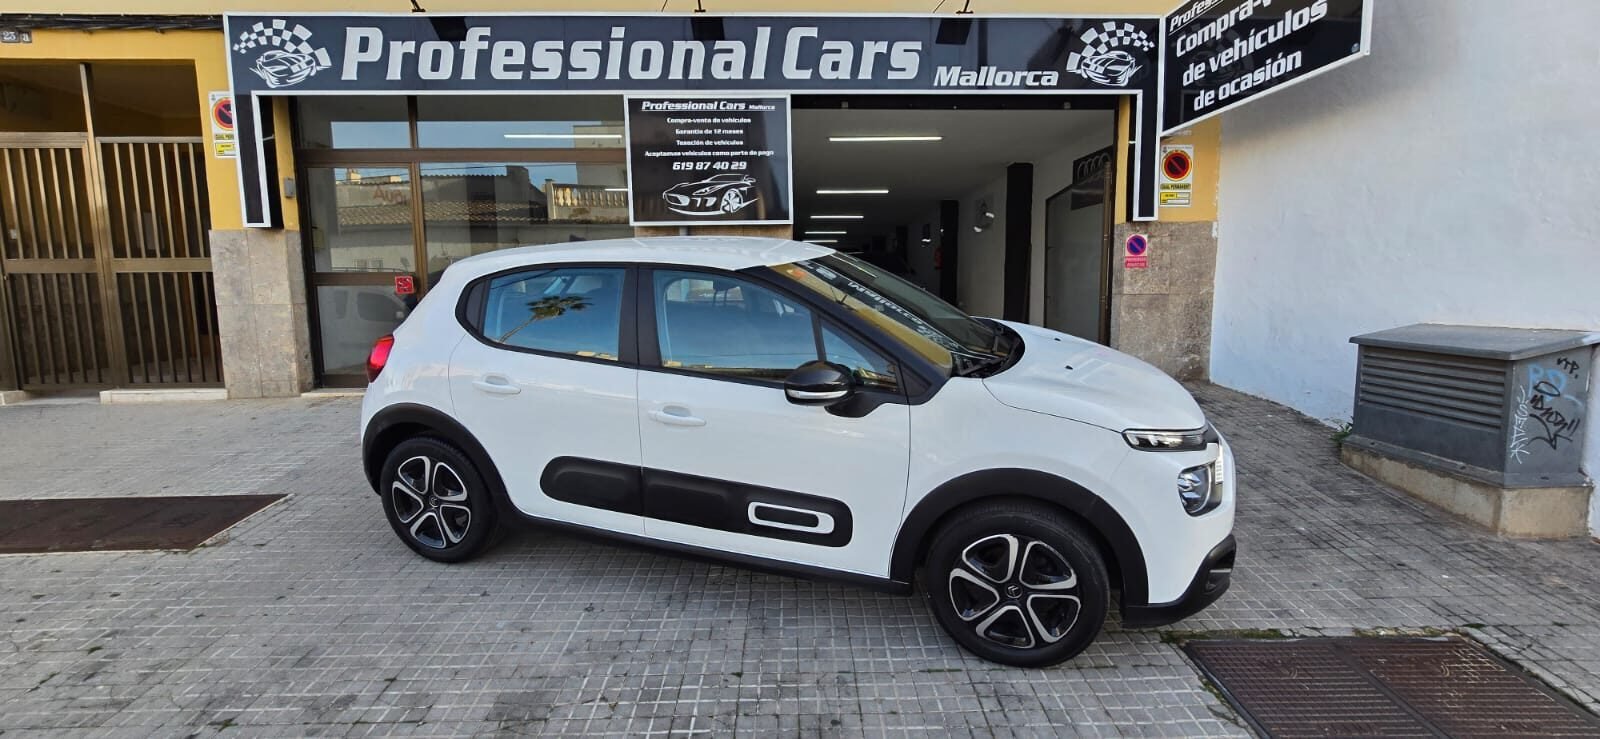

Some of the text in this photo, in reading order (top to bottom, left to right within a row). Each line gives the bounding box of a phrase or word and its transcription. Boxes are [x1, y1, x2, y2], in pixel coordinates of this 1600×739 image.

[1183, 0, 1328, 86] de vehículos
[341, 26, 1059, 87] Professional Cars Mallorca
[1194, 52, 1302, 111] de ocasión
[641, 100, 718, 110] Professional
[719, 101, 746, 110] Cars
[666, 117, 712, 125] Compra-venta
[644, 150, 681, 158] Aceptamos
[758, 149, 774, 157] pago
[672, 161, 747, 171] 619 87 40 29
